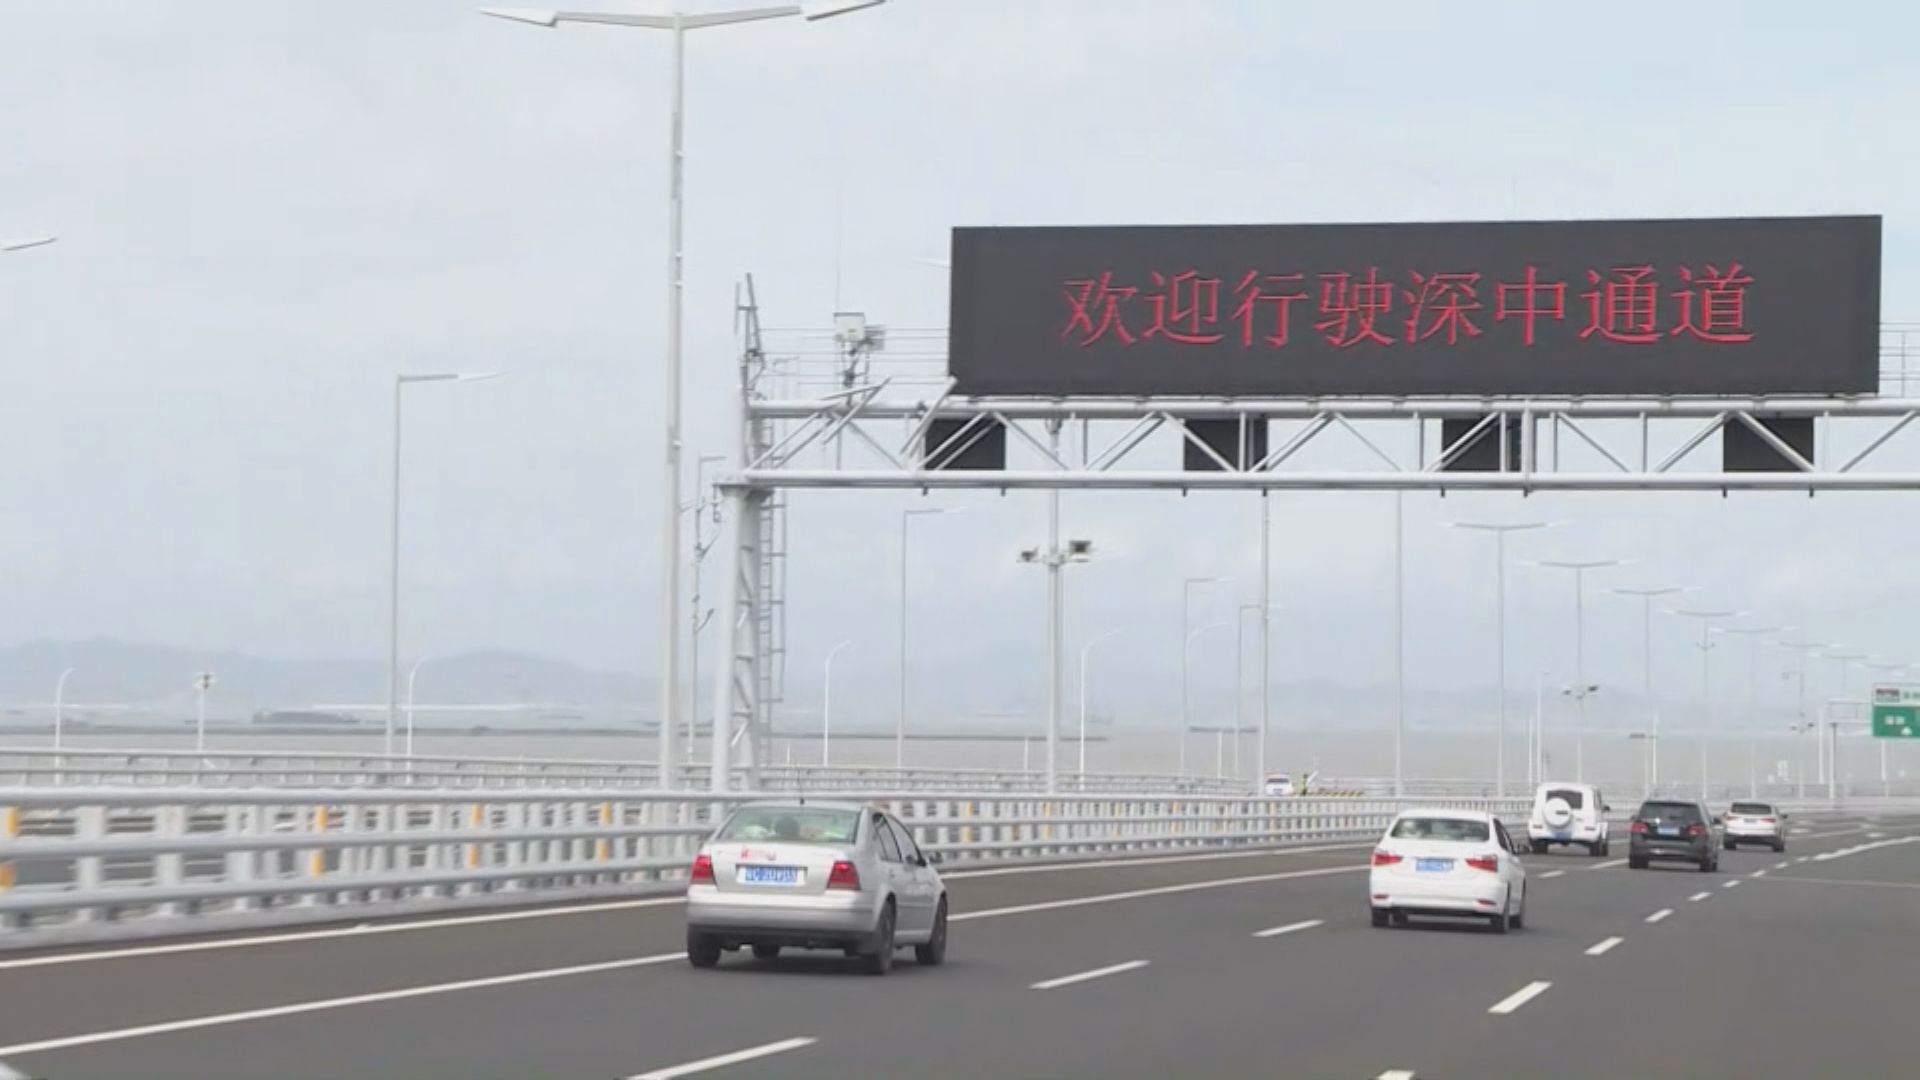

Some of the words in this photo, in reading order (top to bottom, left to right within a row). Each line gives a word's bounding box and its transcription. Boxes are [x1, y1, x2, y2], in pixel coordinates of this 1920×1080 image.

[1063, 262, 1756, 348] 欢迎行驶深中通道
